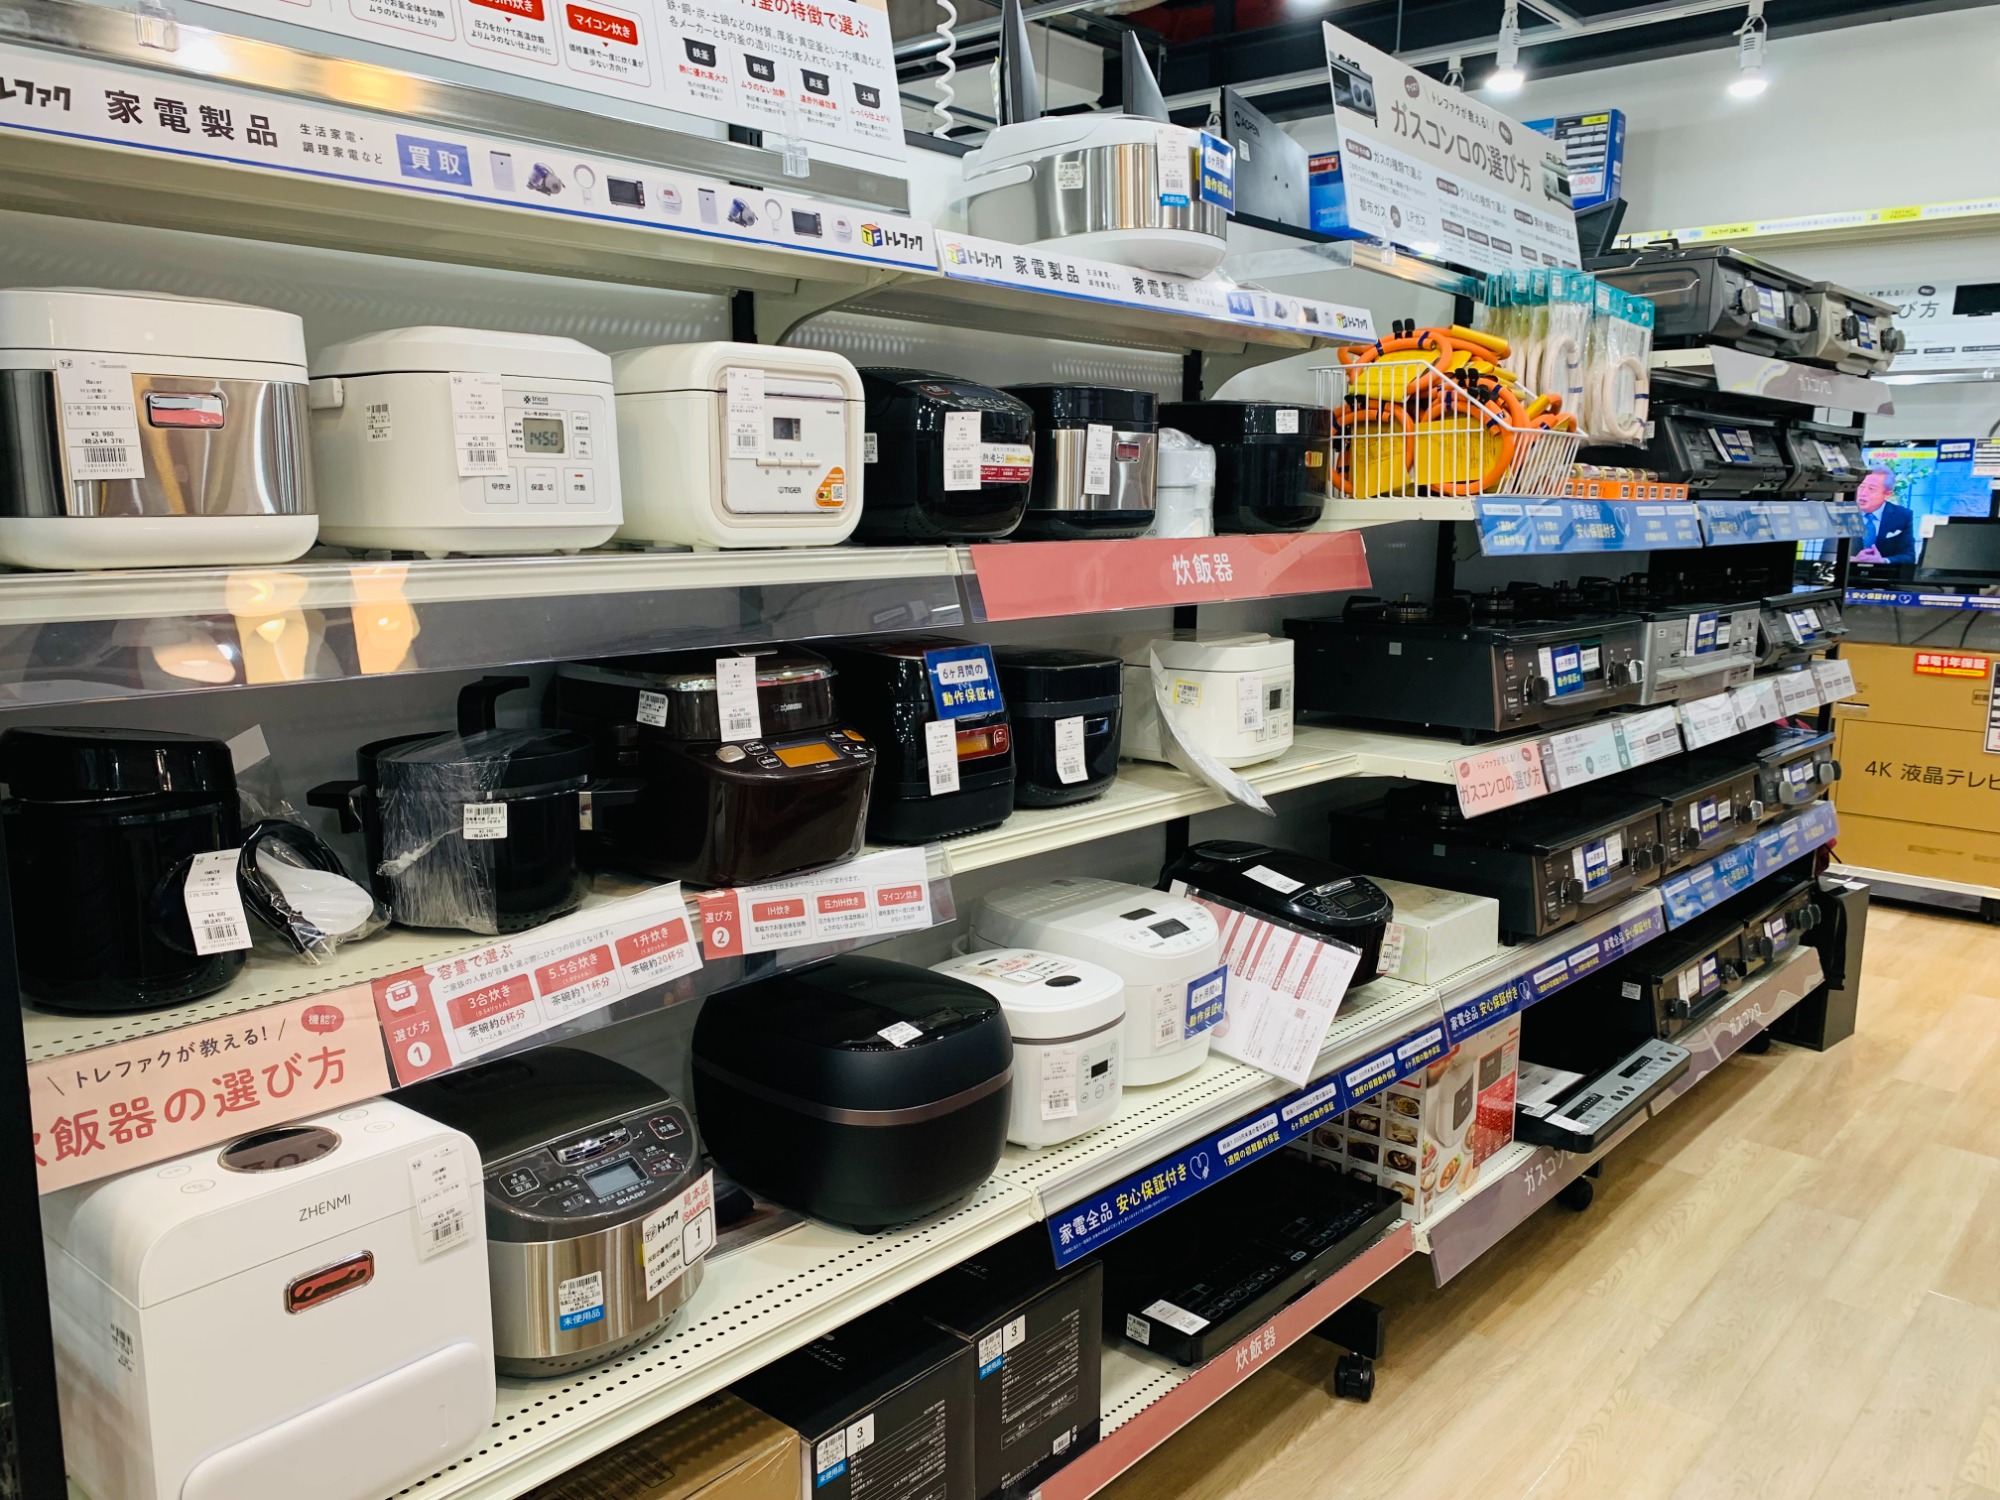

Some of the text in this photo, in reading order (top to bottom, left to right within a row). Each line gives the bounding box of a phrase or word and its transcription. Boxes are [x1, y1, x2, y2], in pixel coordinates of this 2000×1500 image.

[368, 5, 438, 28] ムラのない仕上がり
[573, 13, 632, 39] マイコン炊き
[470, 30, 553, 56] よりムラのない仕上がりに
[104, 89, 280, 148] 家電製品
[302, 140, 385, 165] 調理家電など
[1391, 100, 1532, 192] ガスコンロの選び方
[408, 144, 463, 178] 買取
[884, 229, 923, 252] トレファク
[966, 249, 1081, 284] トレファク 家電製品
[1131, 275, 1190, 303] 家電製品
[1897, 300, 1941, 320] び方
[491, 482, 512, 492] 早炊き
[573, 483, 587, 492] 炊飯
[784, 486, 802, 494] TIGER
[1574, 523, 1617, 540] 安心保証付き
[1171, 552, 1234, 587] 炊飯器
[1851, 592, 1897, 601] 安心保証付き
[942, 664, 984, 681] 6ヶ月間の
[1917, 654, 1988, 670] 家電1年保証
[942, 687, 996, 708] 動作保証付
[1864, 760, 1893, 778] 4K
[1459, 767, 1542, 806] ガスコンロの選び方
[823, 897, 861, 910] 圧力IH炊き
[881, 889, 919, 902] マイコン炊き
[704, 910, 734, 924] 選び方
[766, 904, 792, 916] IH炊き
[632, 926, 671, 949] 1升炊き
[716, 930, 726, 945] 2
[760, 929, 803, 941] ムラのない仕上がり
[1603, 917, 1653, 952] 家電全品 安心保証付き
[437, 943, 515, 982] 容量で選ぶ
[442, 929, 615, 994] ご家族の人数が容量を選ぶ際にひとつの目安となります。
[547, 952, 599, 982] 5.5合炊き
[629, 946, 686, 977] 茶碗約20杯分
[467, 984, 512, 1010] 3合炊き
[550, 975, 612, 1007] 茶碗約11杯分
[308, 1013, 337, 1027] 機能?
[1450, 1006, 1479, 1032] 家電全品
[1479, 986, 1519, 1017] 安心保証付き
[1728, 1002, 1763, 1039] ガスコンロ
[393, 1019, 431, 1045] 選び方
[467, 1008, 527, 1039] 茶碗約6杯分
[75, 1026, 268, 1089] トレファクが教える!
[411, 1046, 425, 1063] 1
[1404, 1043, 1442, 1070] 6ヶ月間の動作保証
[1350, 1067, 1398, 1099] 1週間の初期動作保証
[658, 1122, 678, 1134] 炊飯
[1289, 1100, 1336, 1132] 6ヶ月間の動作保証
[1223, 1130, 1282, 1168] 1週間の初期動作保証
[509, 1173, 528, 1186] 保温
[515, 1182, 533, 1194] 取消
[555, 1178, 574, 1190] 予約
[615, 1189, 647, 1207] SHARP
[682, 1179, 710, 1209] 見本品
[1058, 1202, 1114, 1246] 家電全品
[1115, 1162, 1188, 1217] 安心保証付き
[298, 1192, 352, 1223] ZHENMI
[656, 1209, 679, 1234] トレファク
[695, 1225, 702, 1240] 1
[563, 1308, 601, 1326] 未使用品
[1010, 1325, 1018, 1338] 3
[1234, 1325, 1277, 1374] 炊飯器
[980, 1359, 1002, 1377] 未使用品
[856, 1426, 864, 1439] 3
[818, 1462, 845, 1484] 未使用品
